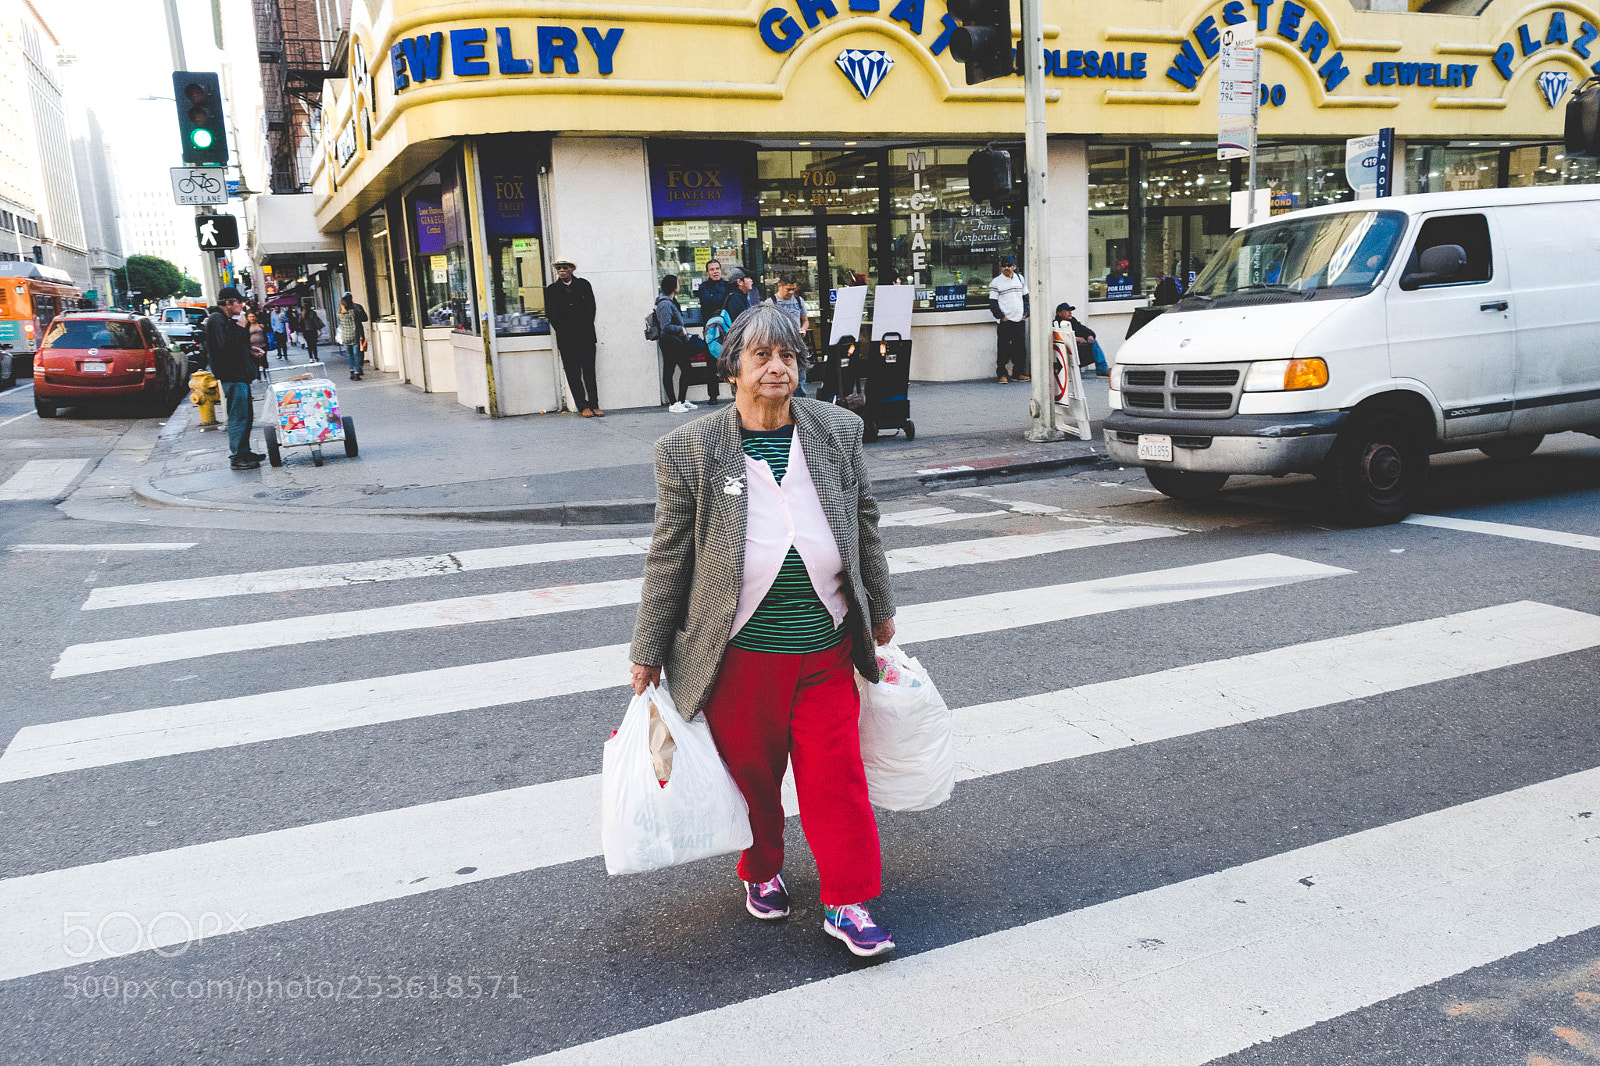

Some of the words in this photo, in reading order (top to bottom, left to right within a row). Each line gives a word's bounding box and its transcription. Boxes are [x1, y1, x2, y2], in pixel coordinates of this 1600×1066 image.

[759, 0, 957, 56] GRAT
[1166, 0, 1350, 92] WESTERN
[1235, 38, 1253, 47] Metro
[1222, 48, 1230, 57] 94
[390, 25, 625, 95] EWELRY
[1012, 48, 1147, 79] OLESALE
[1222, 60, 1230, 68] 94
[1366, 62, 1479, 88] JEWELRY
[1220, 81, 1234, 91] 728
[1220, 92, 1234, 102] 794
[1260, 83, 1287, 107] 00
[1363, 157, 1378, 167] 419
[1378, 140, 1387, 197] LADOT
[667, 170, 723, 188] FOX
[800, 170, 837, 187] 700
[495, 182, 525, 200] FOX
[666, 190, 723, 203] JEWELRY
[180, 195, 198, 203] BIKE
[201, 195, 222, 203] LANE
[811, 193, 850, 206] HILL
[960, 203, 1005, 217] Michael
[906, 151, 926, 289] MICHAEL
[970, 218, 998, 231] Time
[1252, 271, 1261, 284] Go
[949, 293, 966, 301] LEASE
